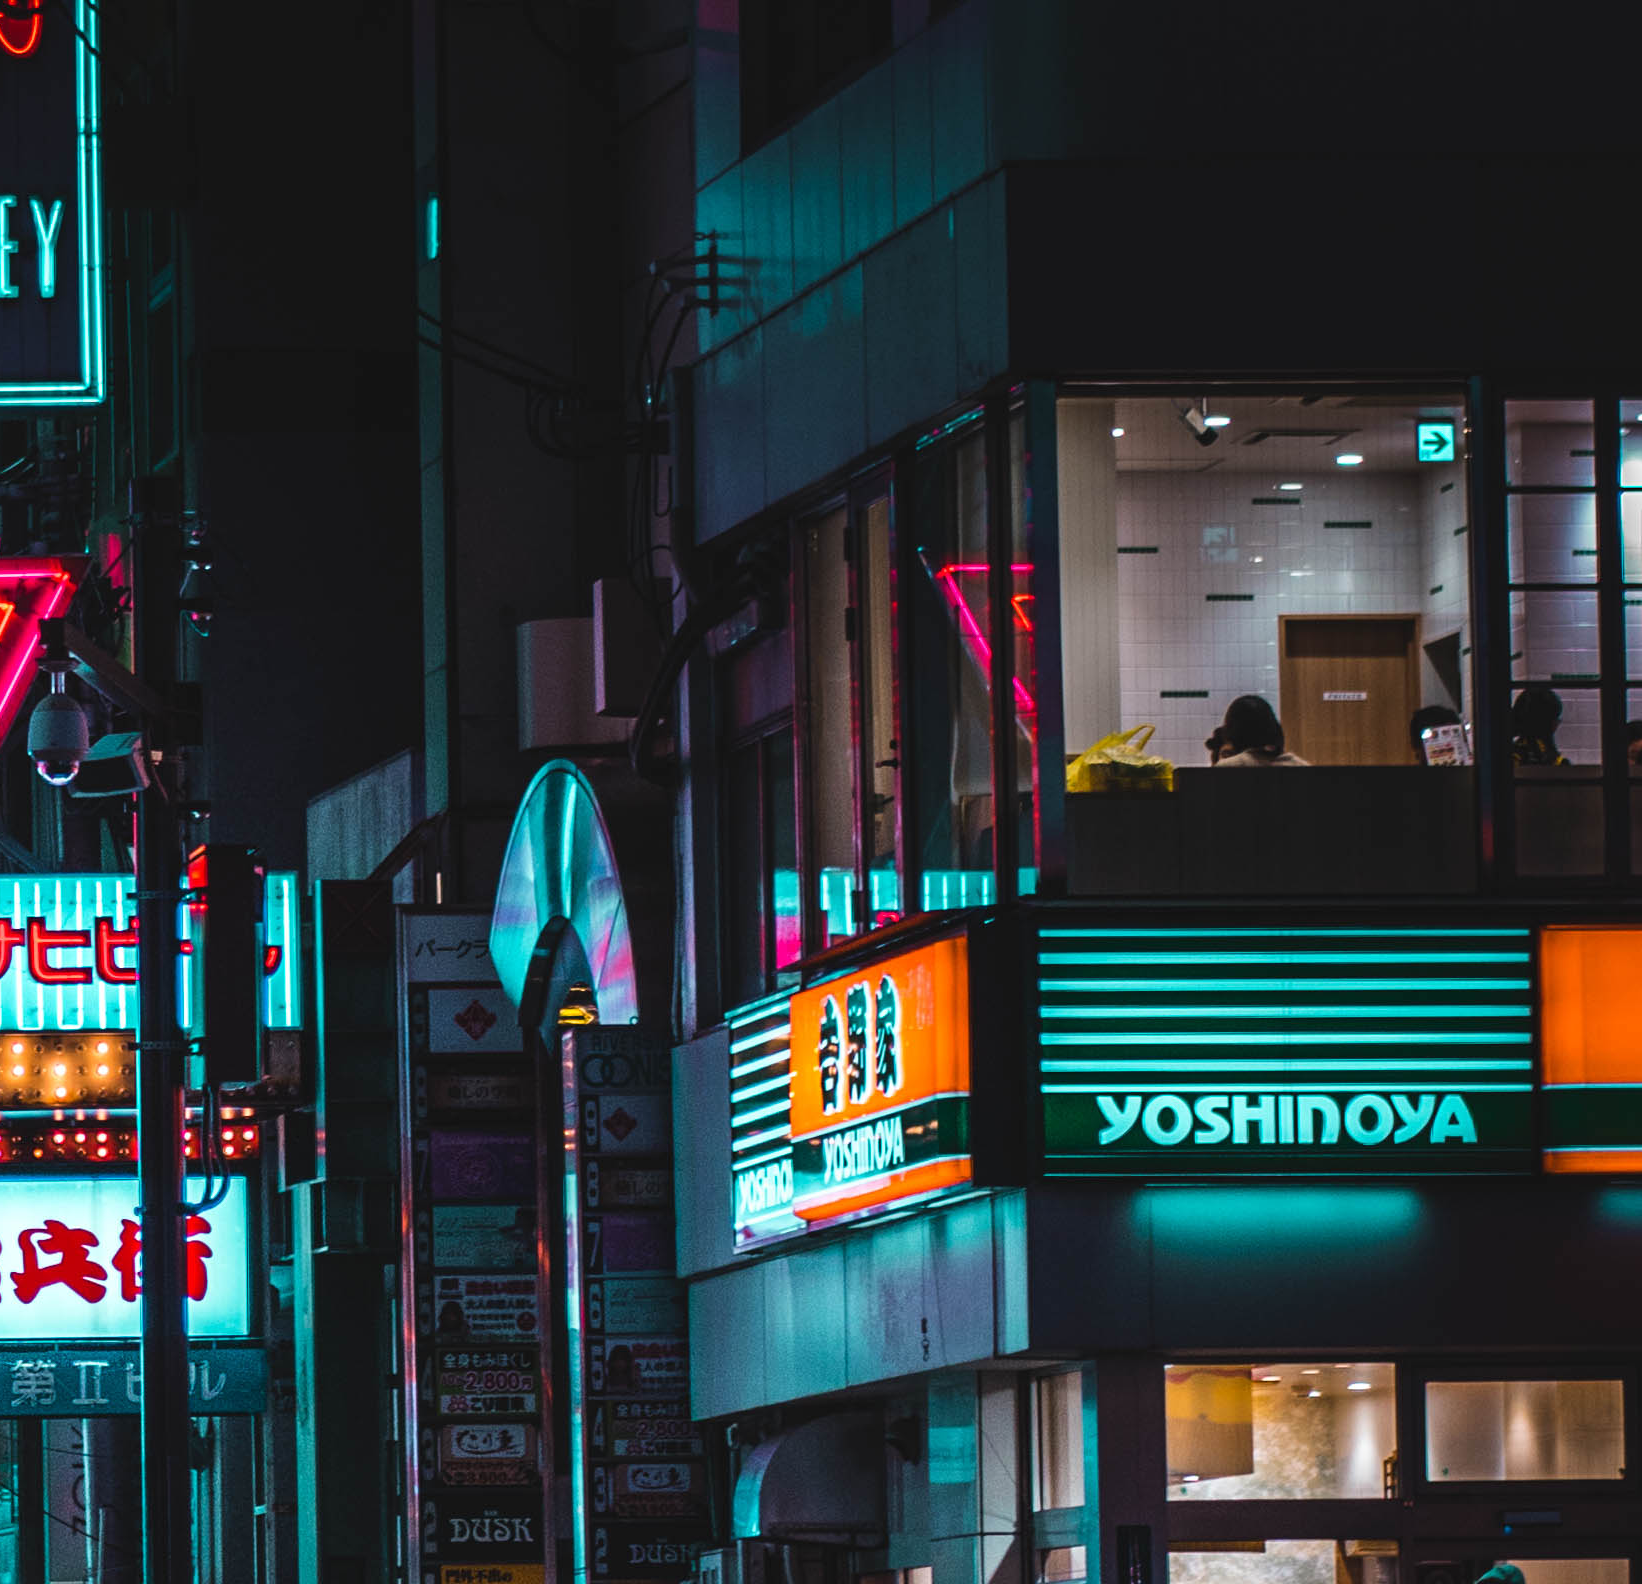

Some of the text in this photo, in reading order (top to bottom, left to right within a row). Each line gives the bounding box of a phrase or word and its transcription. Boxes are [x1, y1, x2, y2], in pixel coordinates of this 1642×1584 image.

[1095, 1094, 1477, 1145] YOSHINOYA
[822, 1116, 905, 1185] YOSHINOYA
[738, 1158, 794, 1216] YOSHINO
[449, 1517, 535, 1543] DUSK
